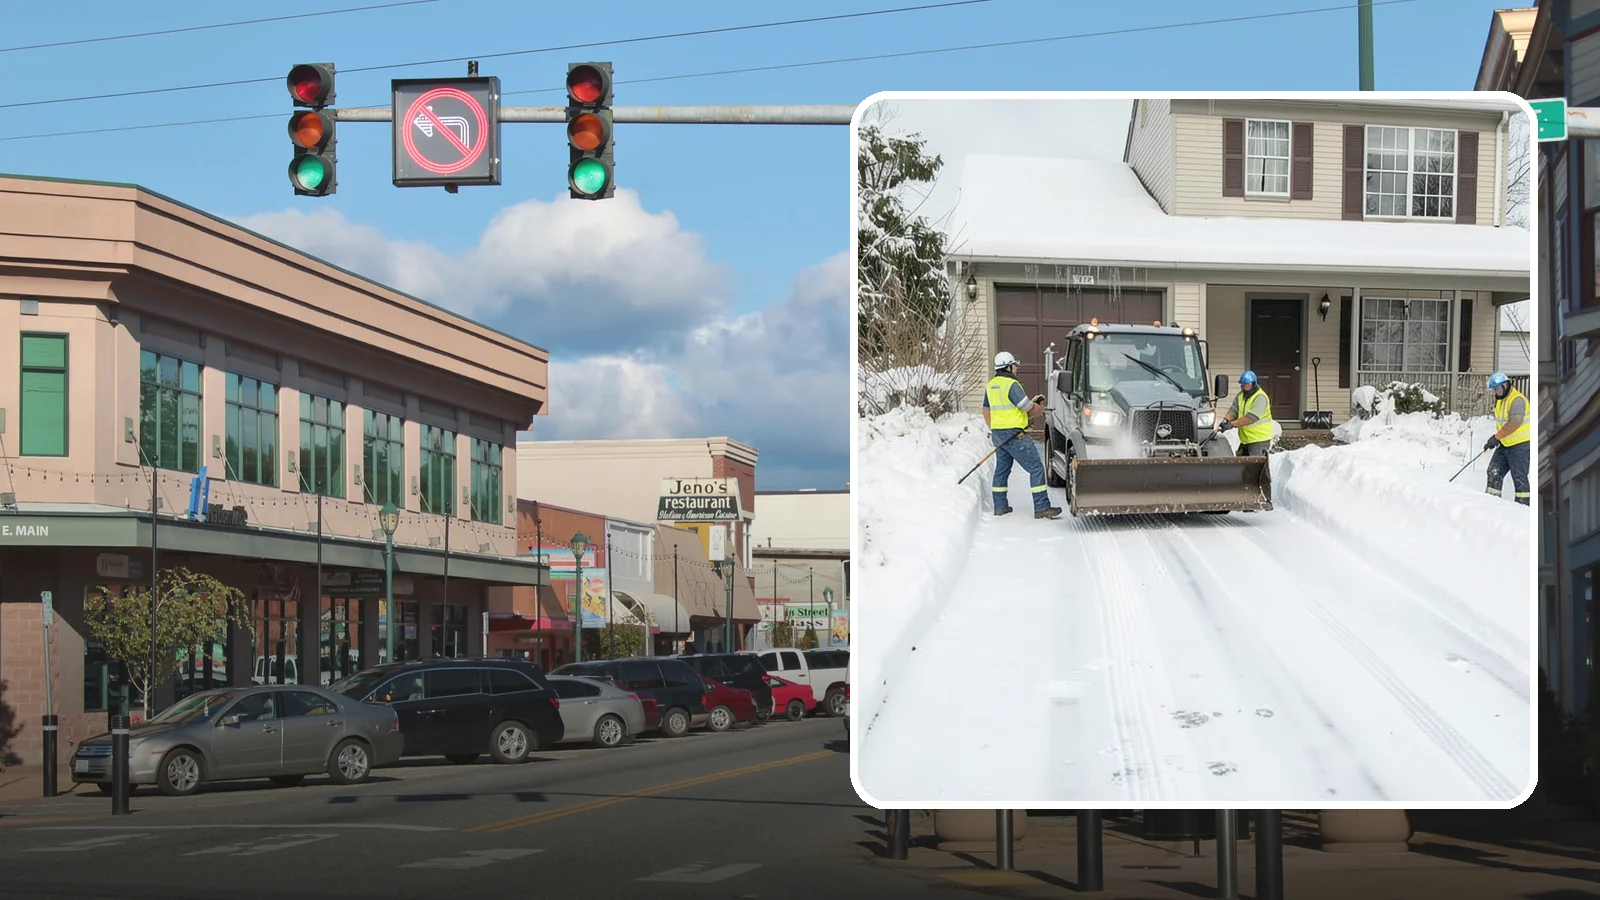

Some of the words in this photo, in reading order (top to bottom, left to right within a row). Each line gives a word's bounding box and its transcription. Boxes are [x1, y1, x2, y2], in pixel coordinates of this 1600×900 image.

[669, 480, 728, 494] Jeno's
[665, 496, 731, 509] restaurant
[658, 509, 681, 519] Italian
[685, 509, 714, 519] American
[714, 509, 738, 519] Cuisine
[2, 525, 13, 536] E.
[15, 525, 49, 536] MAIN
[797, 607, 829, 617] Street
[791, 619, 824, 627] lass
